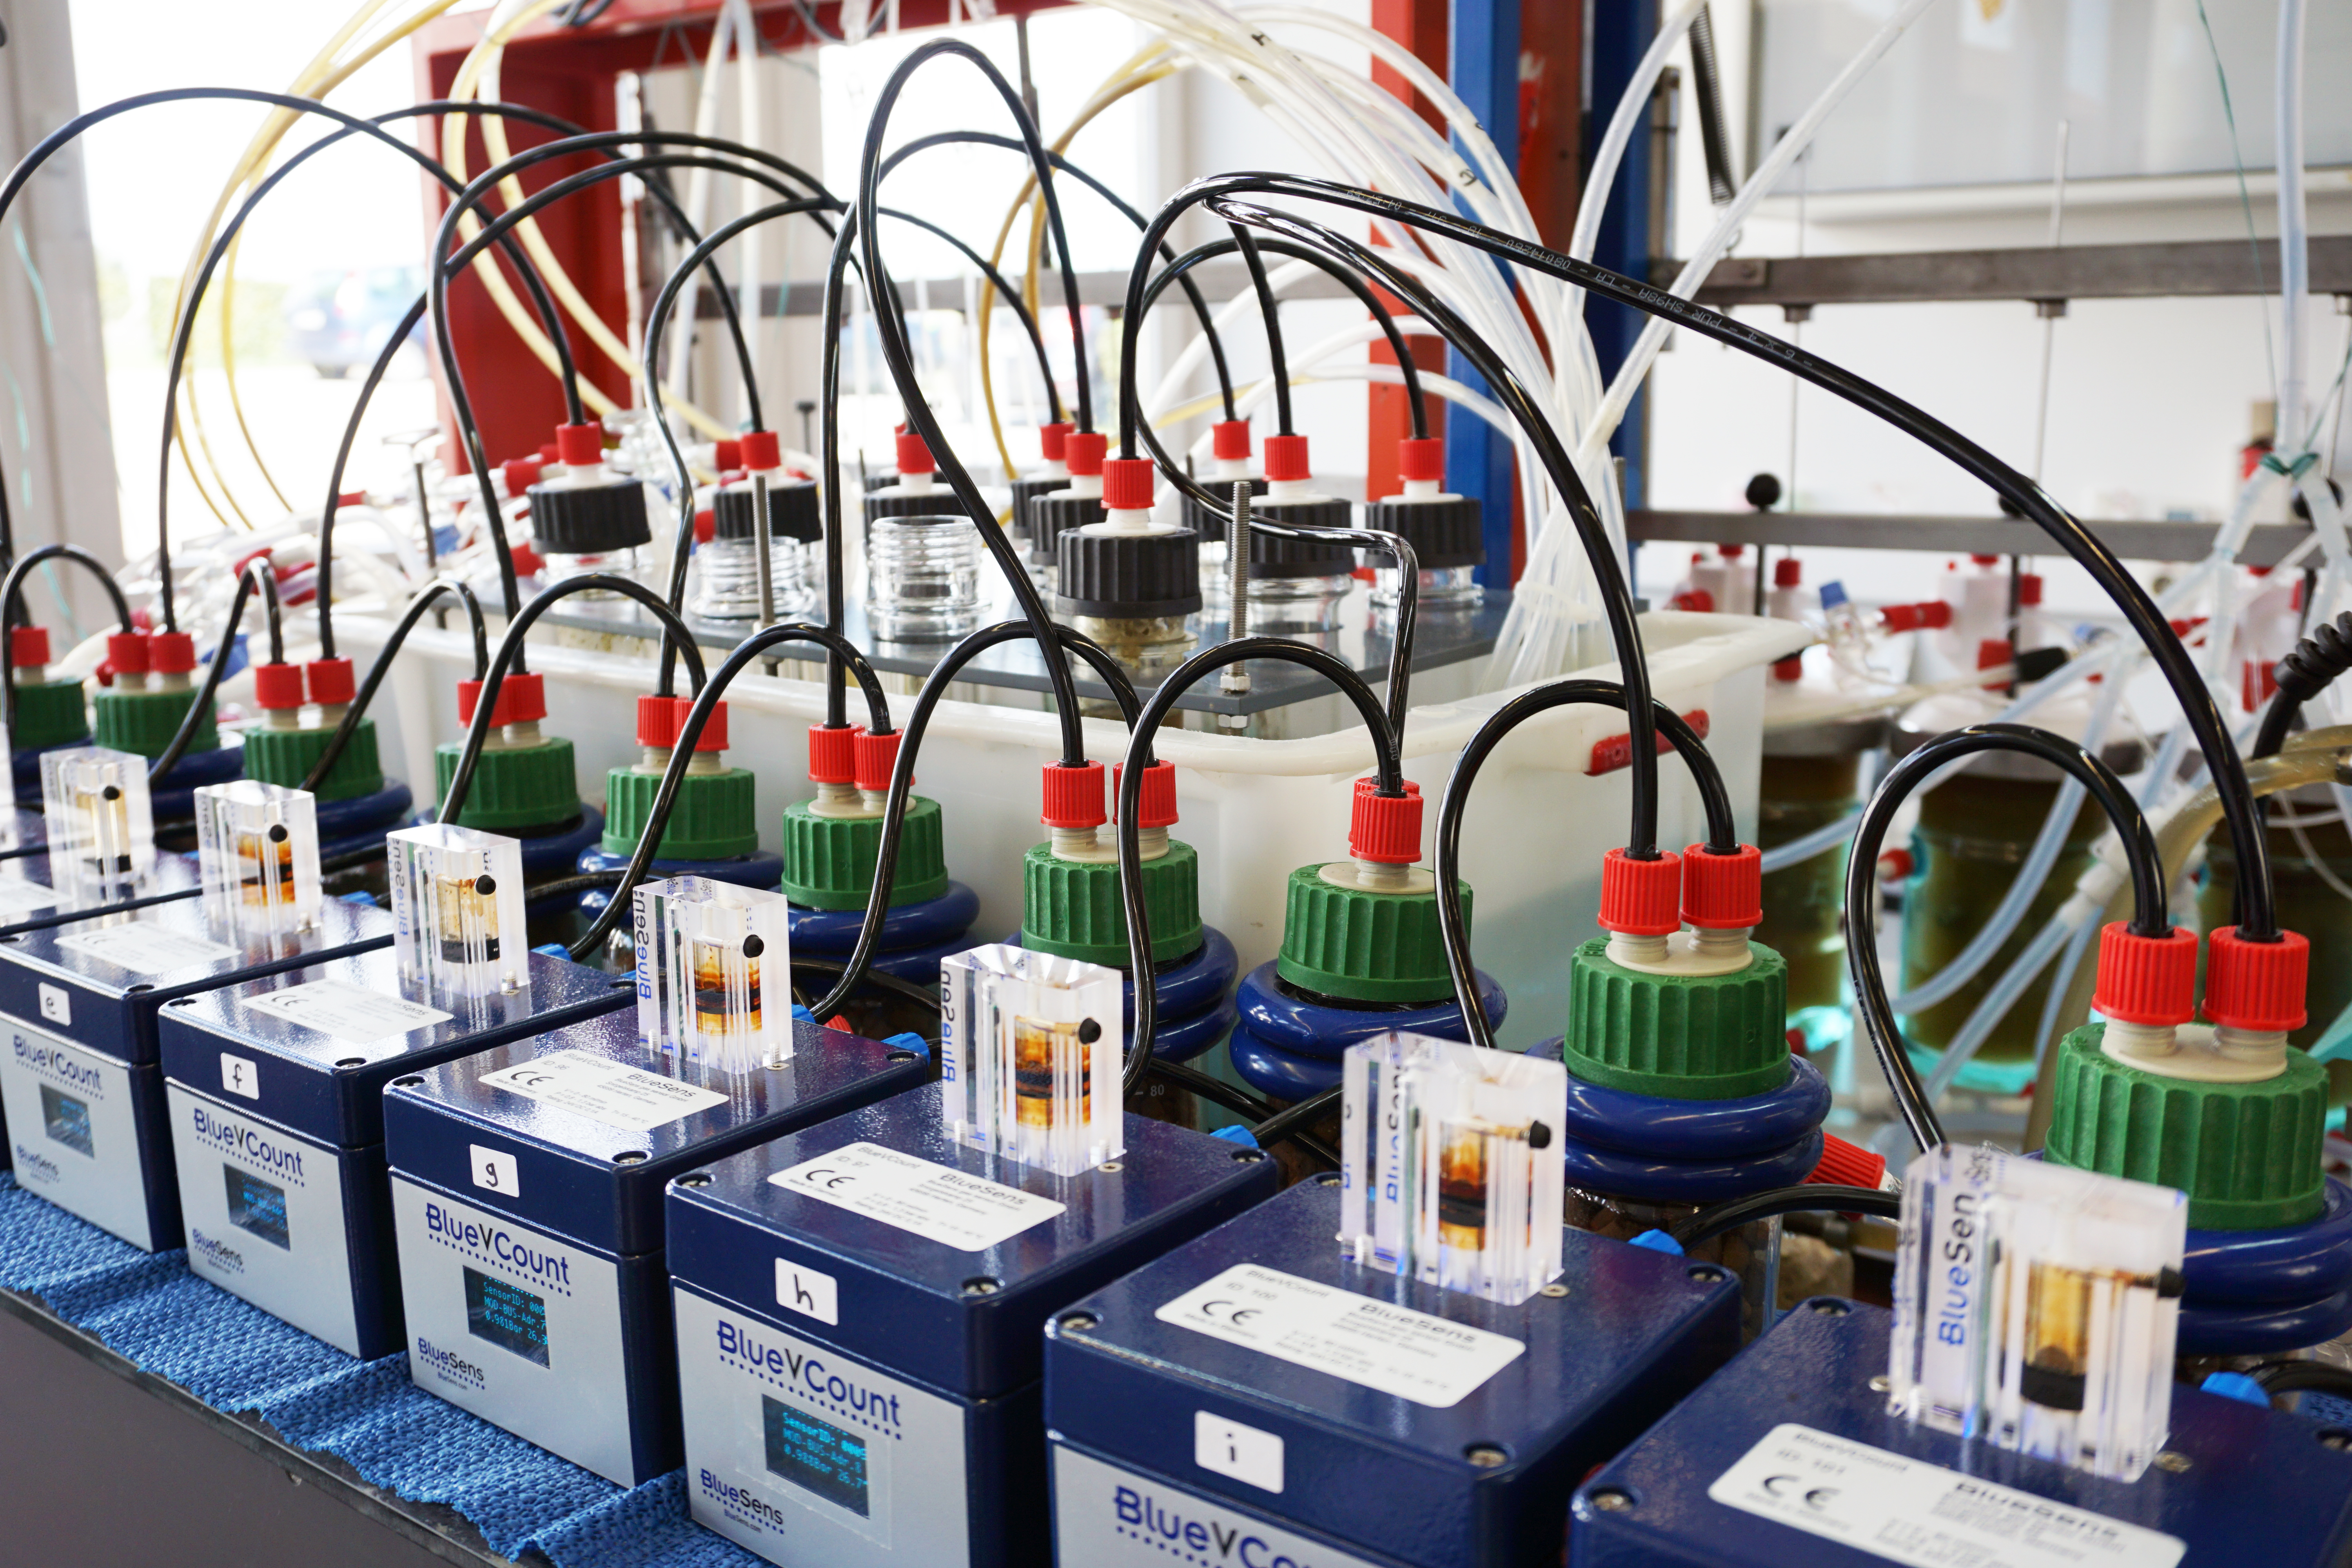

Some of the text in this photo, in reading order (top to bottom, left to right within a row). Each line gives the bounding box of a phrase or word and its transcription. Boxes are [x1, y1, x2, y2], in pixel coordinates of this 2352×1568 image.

[1692, 309, 1722, 329] PUR
[14, 1035, 102, 1091] BlueVCount
[232, 1063, 243, 1089] f
[563, 1053, 615, 1070] BlueVCount
[626, 1073, 697, 1097] BlueSens
[1150, 1084, 1164, 1096] 80
[194, 1108, 304, 1176] BlueVCount
[857, 1146, 921, 1169] BlueVCount
[939, 1173, 1027, 1205] BlueSens
[192, 1228, 244, 1266] BlueSens
[426, 1202, 570, 1286] BlueVCount
[793, 1274, 814, 1311] h
[1359, 1303, 1475, 1343] BlueSens
[418, 1337, 484, 1382] BlueSens
[717, 1319, 901, 1427] BlueVCount
[1226, 1433, 1237, 1462] i
[701, 1468, 784, 1525] BlueSens
[1113, 1485, 1310, 1568] BlueVC
